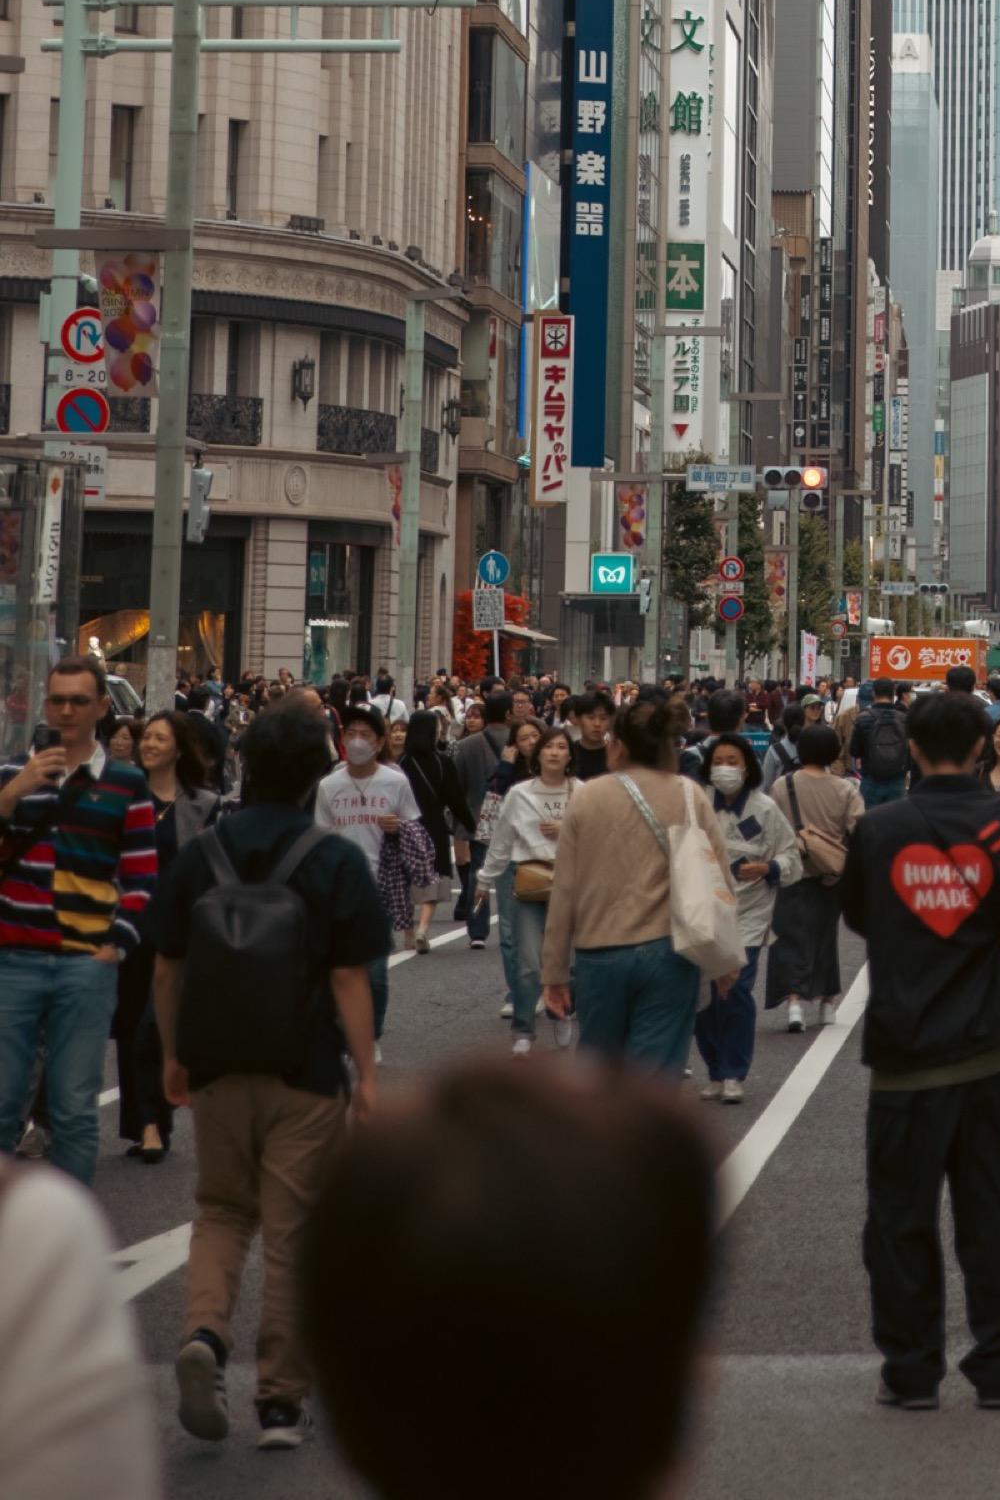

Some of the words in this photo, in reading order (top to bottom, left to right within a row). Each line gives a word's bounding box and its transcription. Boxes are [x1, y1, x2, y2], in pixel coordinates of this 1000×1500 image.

[575, 50, 608, 236] 山野楽器
[667, 254, 700, 299] 本
[65, 369, 106, 382] 8-20
[542, 364, 568, 494] キムラヤのパン
[903, 861, 981, 886] HUMAN
[915, 887, 972, 911] MADE
